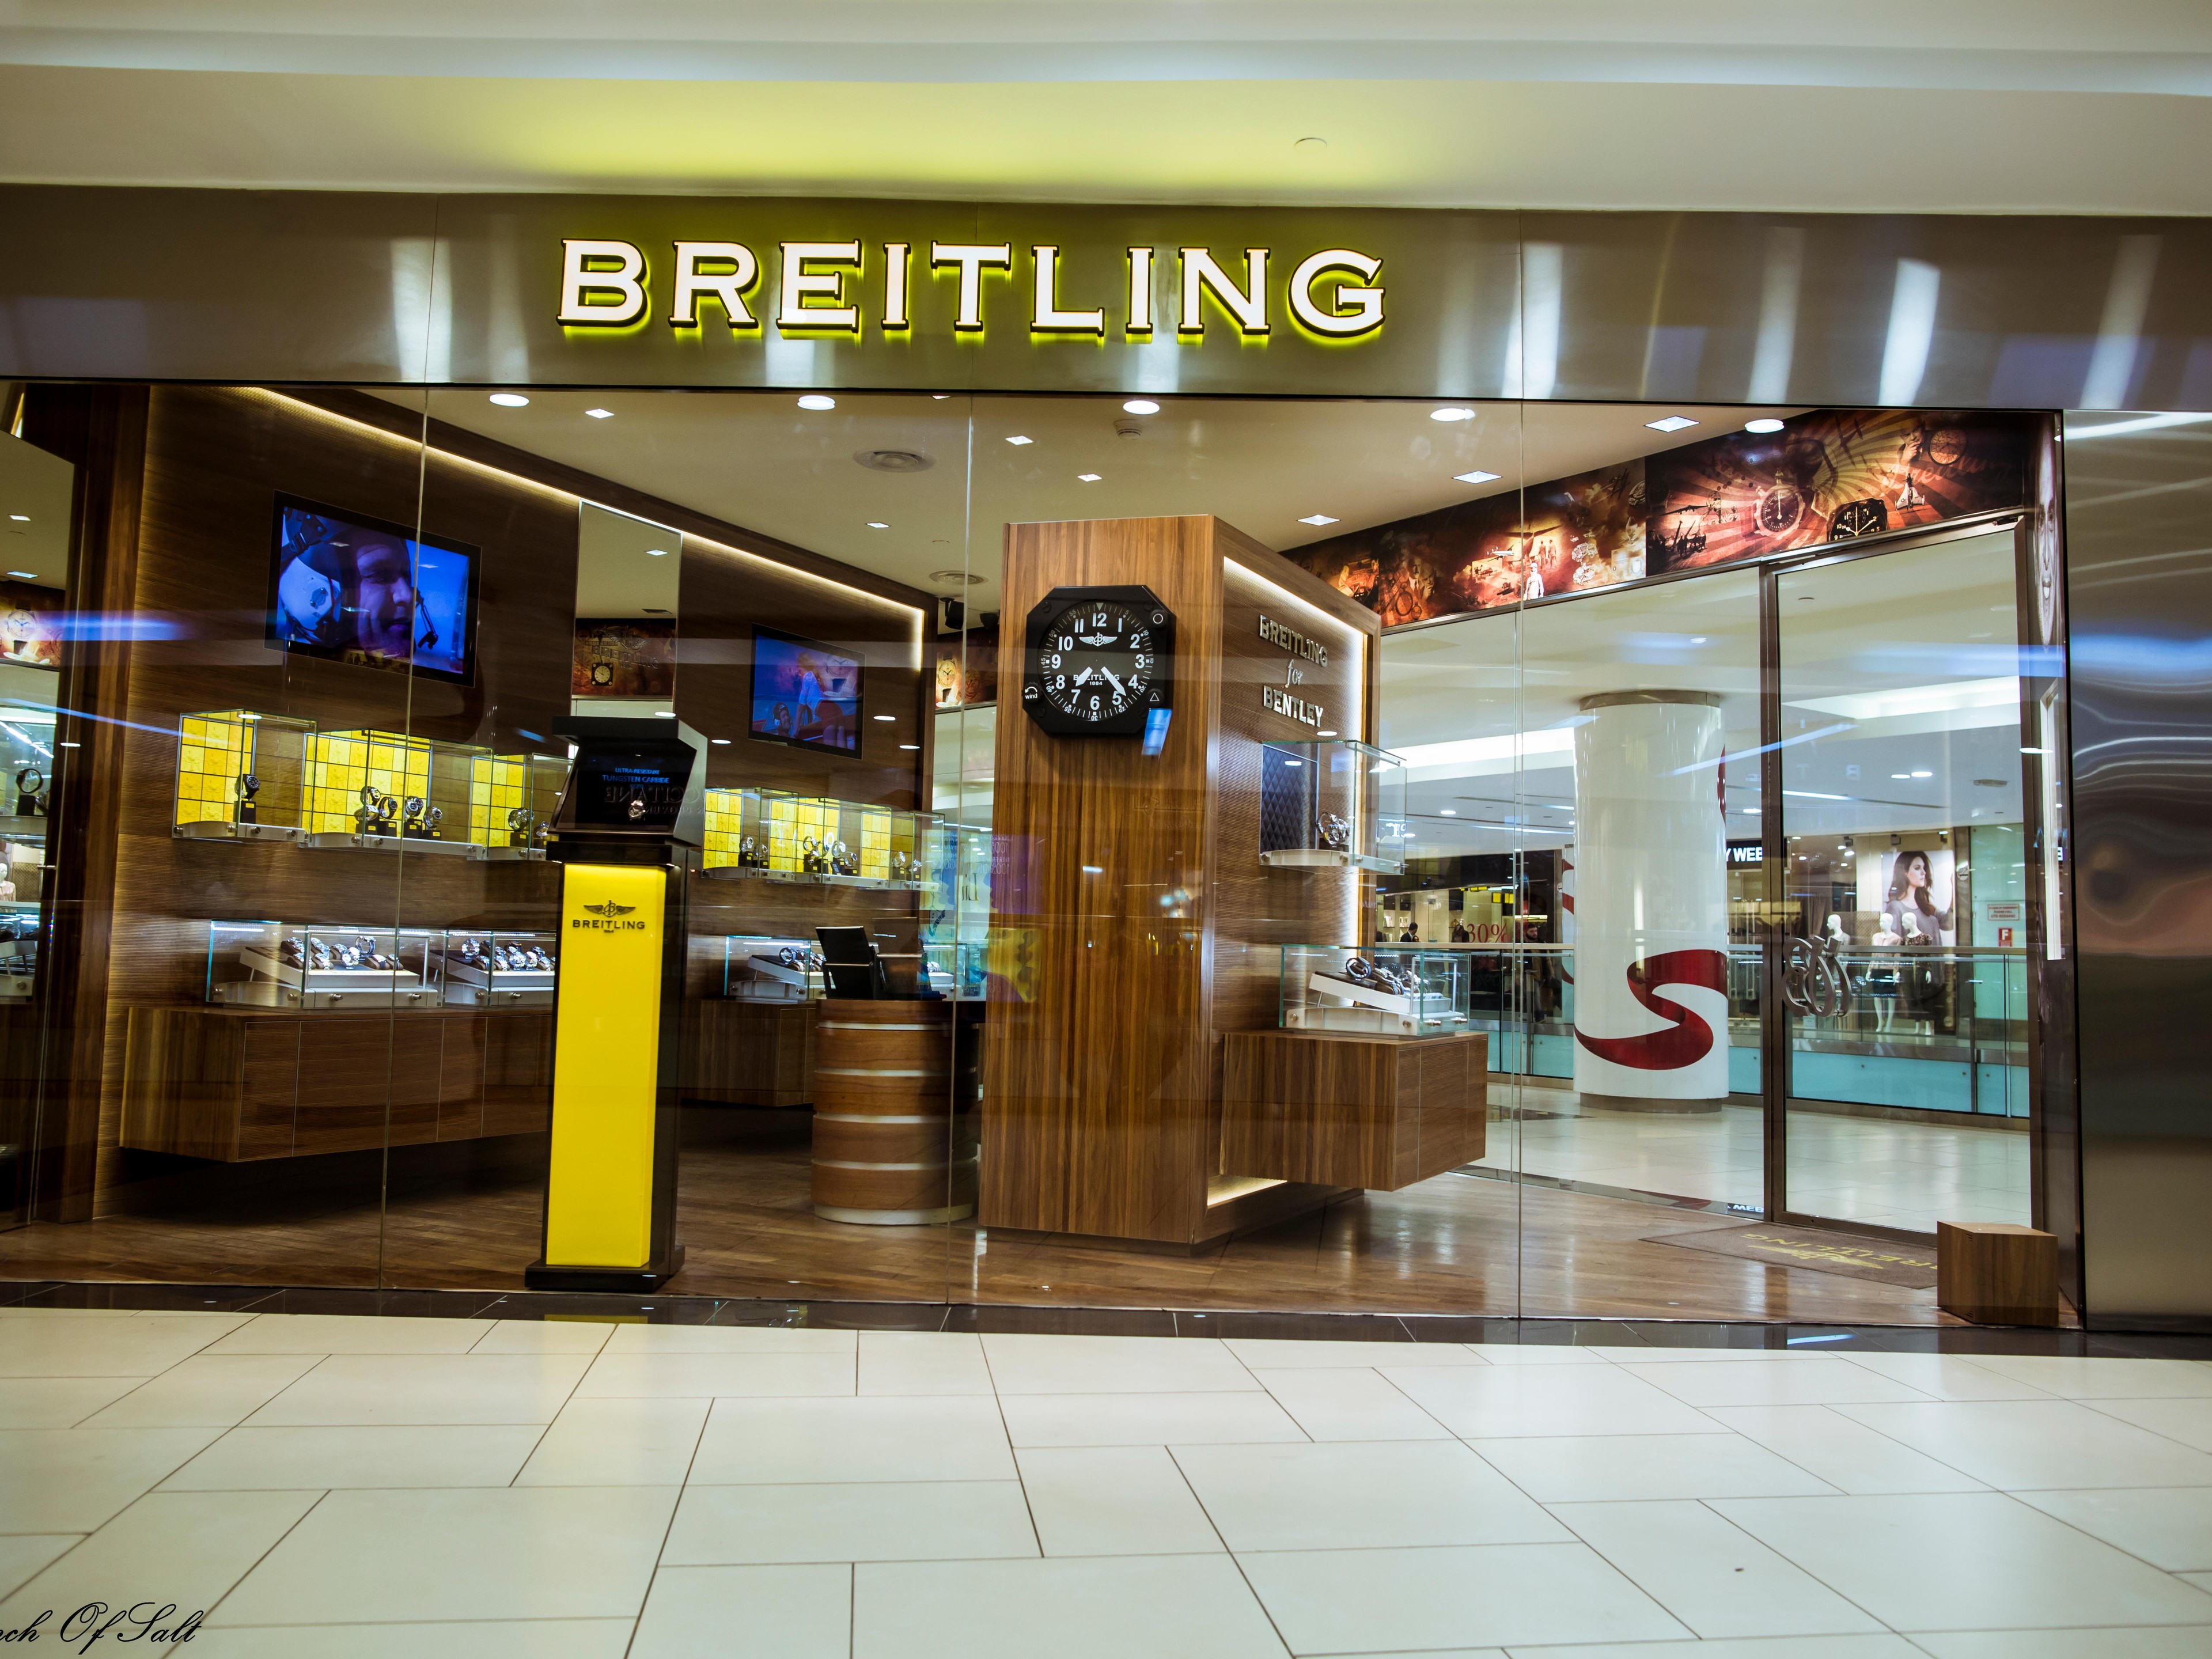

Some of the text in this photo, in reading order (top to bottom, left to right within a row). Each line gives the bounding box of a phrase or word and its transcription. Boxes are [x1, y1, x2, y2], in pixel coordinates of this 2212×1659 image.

[556, 238, 1385, 337] BREITLING
[1075, 619, 1084, 632] 11
[1092, 612, 1107, 627] 12
[1118, 618, 1122, 632] 1
[1059, 637, 1073, 650] 10
[1130, 634, 1139, 648] 2
[1260, 615, 1328, 667] BREITLING
[1051, 654, 1060, 669] 9
[1135, 654, 1145, 668] 3
[1284, 659, 1303, 688] for
[1056, 675, 1065, 689] 8
[1128, 675, 1138, 688] 4
[1071, 690, 1080, 703] 7
[1090, 696, 1100, 710] 6
[1112, 691, 1122, 704] 5
[1263, 685, 1323, 728] BENTLEY
[573, 919, 645, 929] BREITLING
[2002, 929, 2009, 940] F
[1741, 1233, 1937, 1270] REITLING
